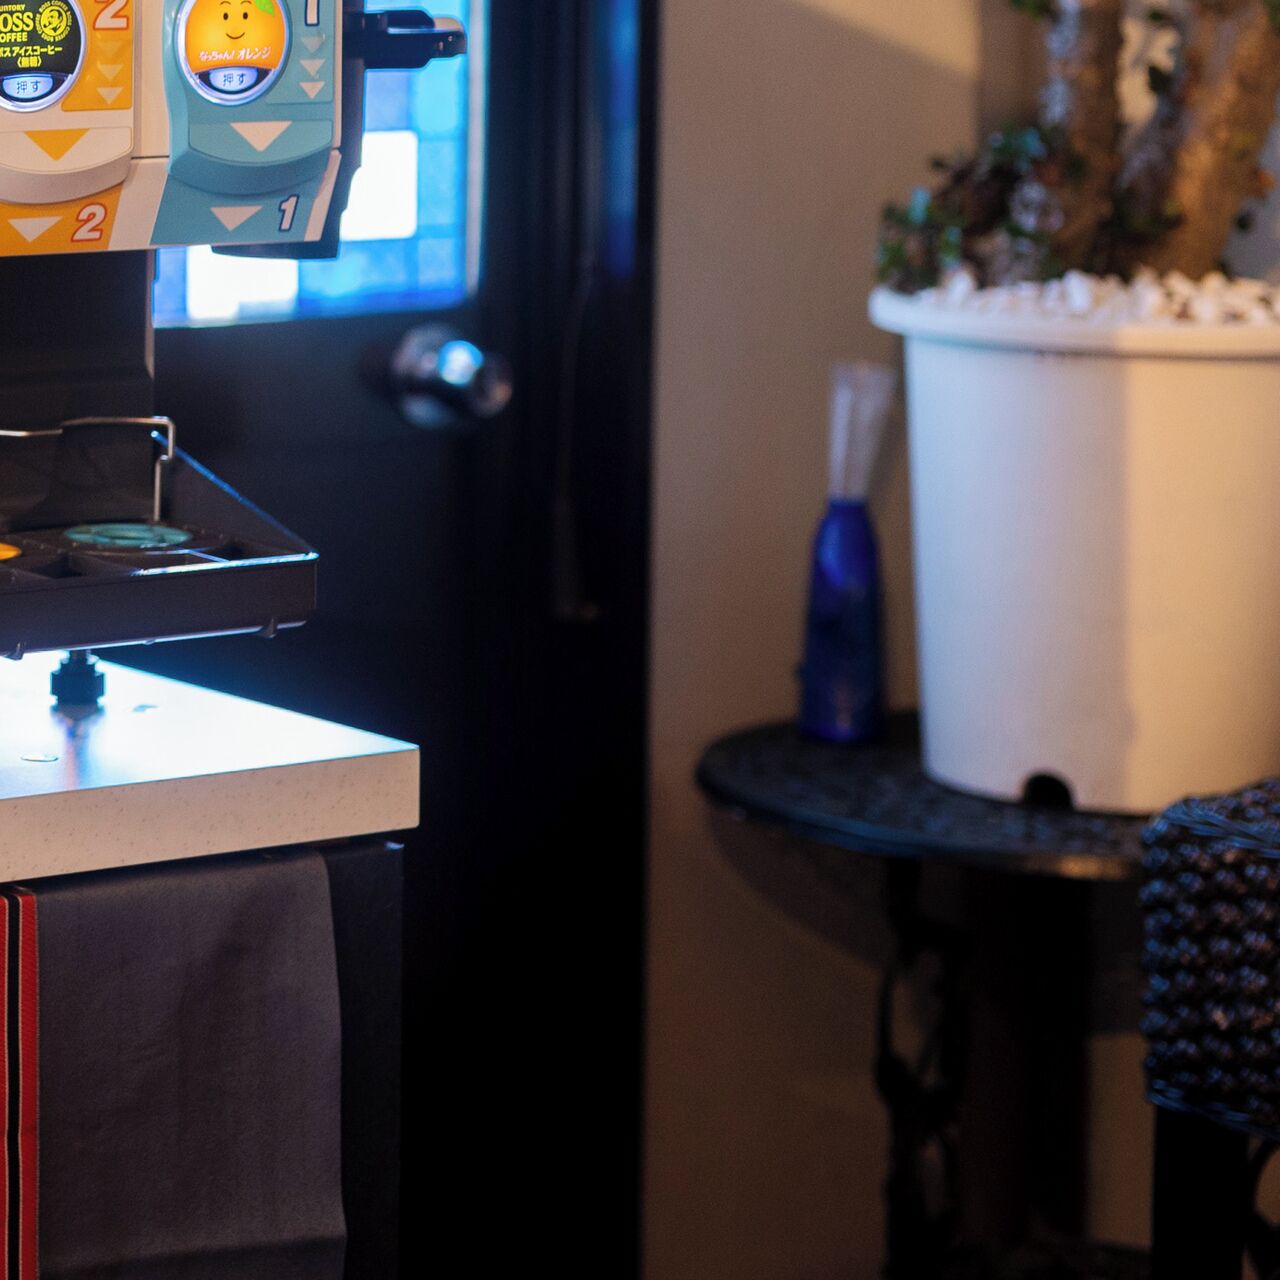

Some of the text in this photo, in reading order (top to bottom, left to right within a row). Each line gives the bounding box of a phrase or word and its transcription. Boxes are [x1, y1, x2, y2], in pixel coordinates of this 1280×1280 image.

[237, 47, 271, 60] オレンジ
[223, 72, 246, 86] 押す
[16, 80, 40, 94] 押す
[278, 195, 299, 232] 1
[70, 203, 107, 243] 2
